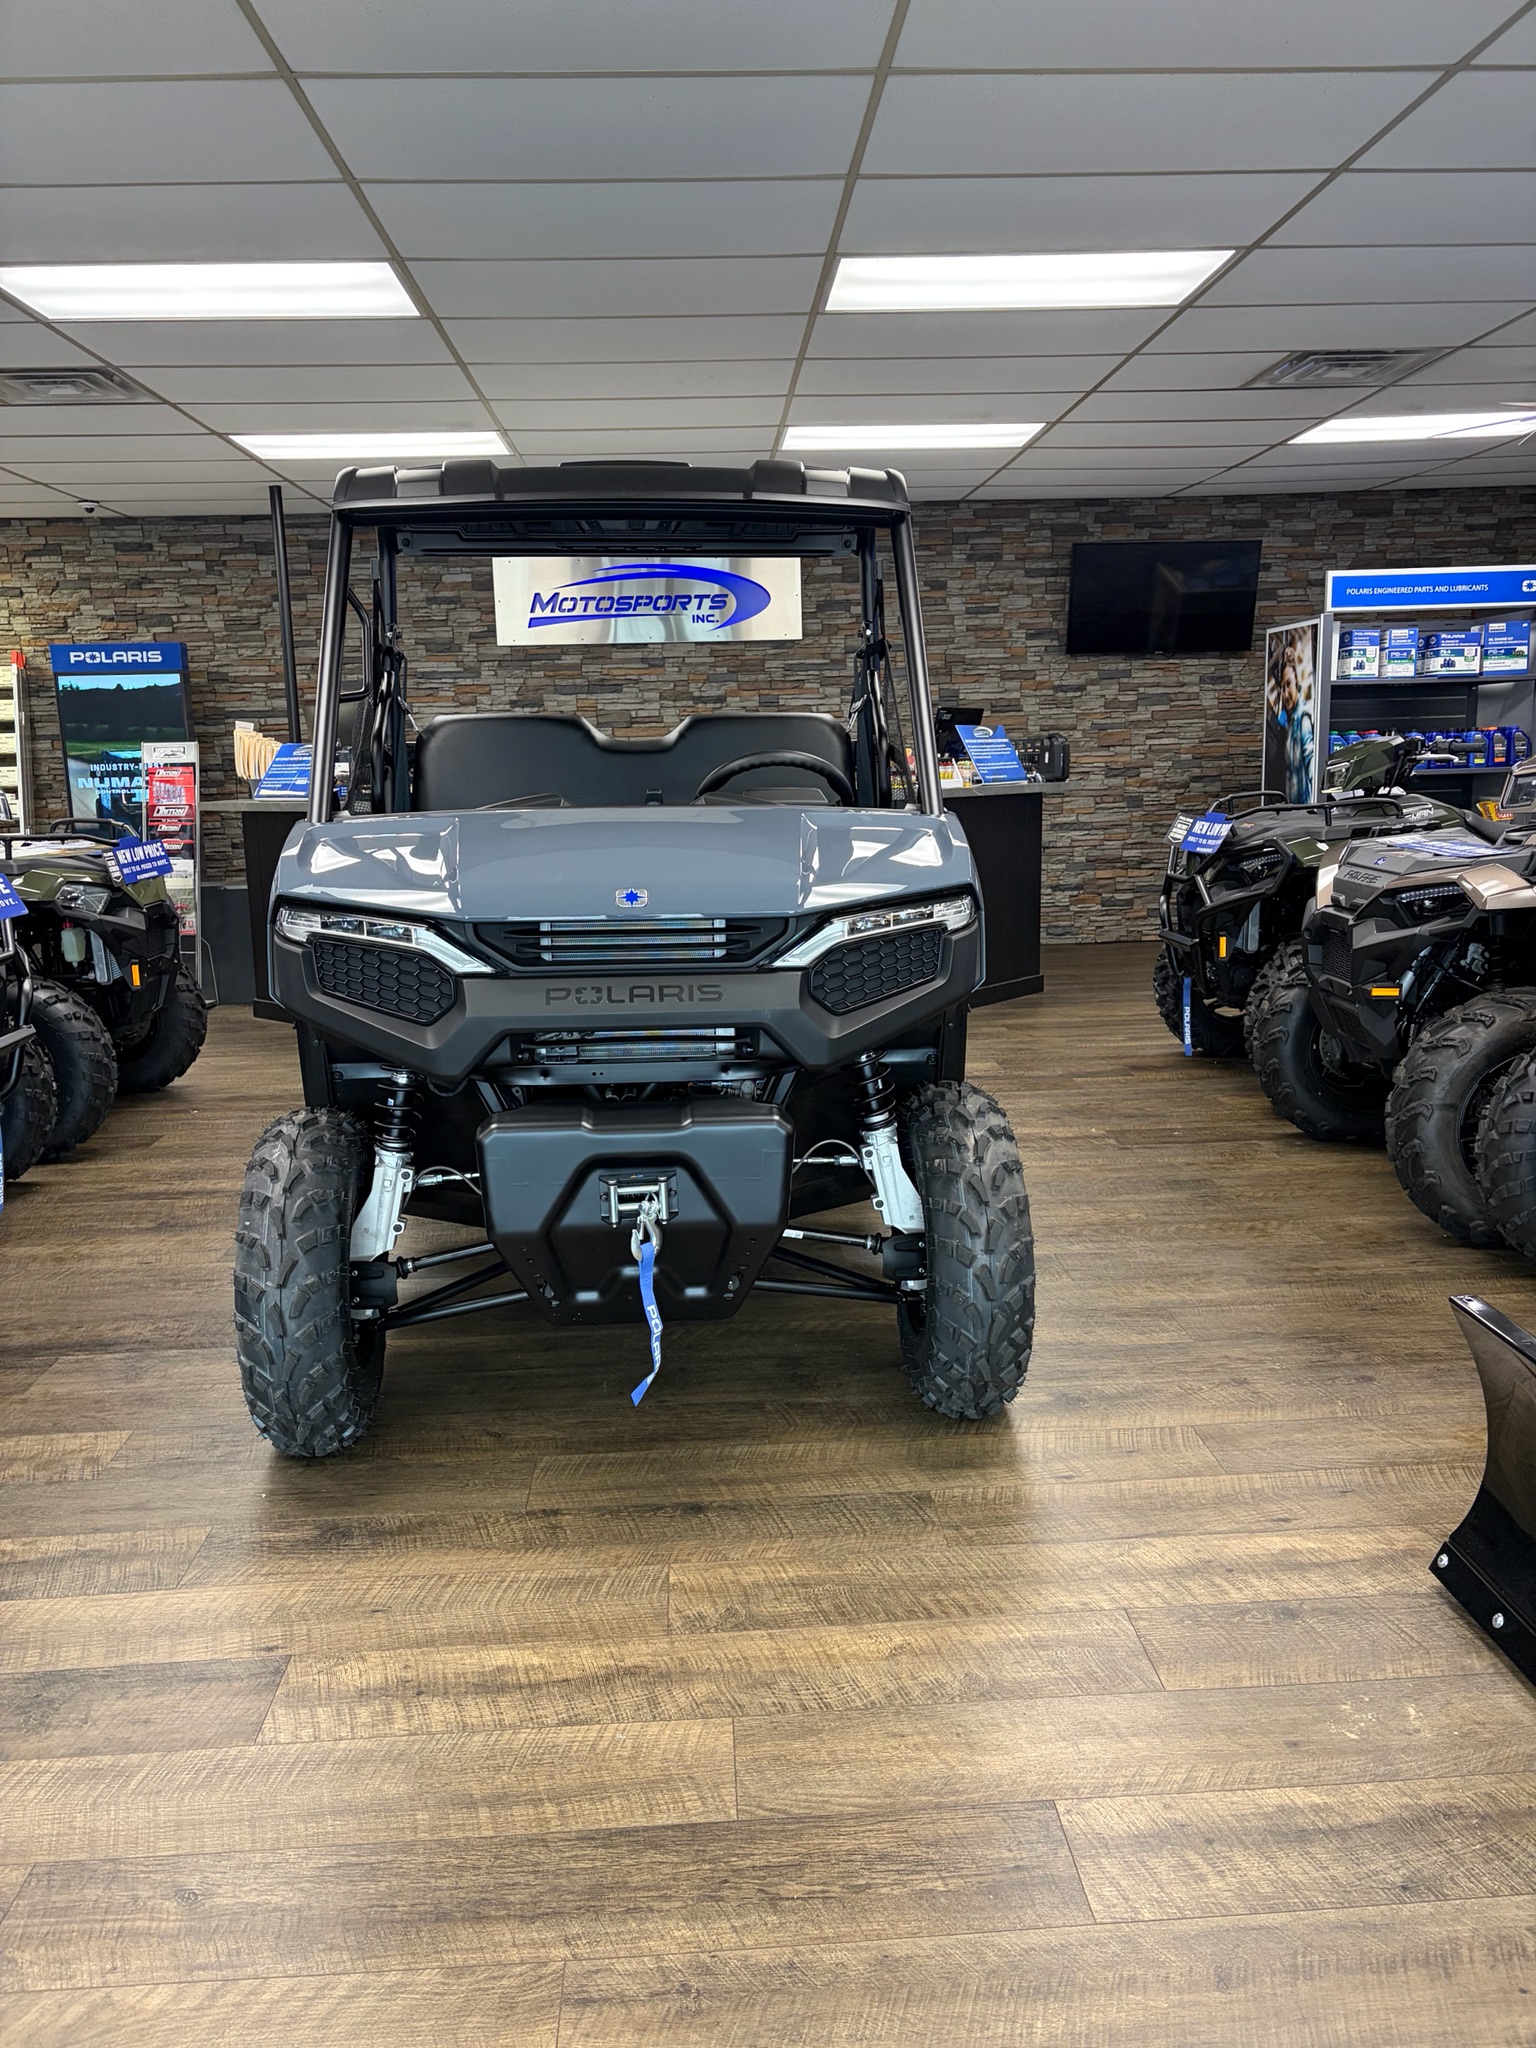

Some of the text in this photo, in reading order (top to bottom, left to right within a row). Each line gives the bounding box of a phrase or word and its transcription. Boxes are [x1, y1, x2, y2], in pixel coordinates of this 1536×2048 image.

[1373, 586, 1413, 594] ENGINEERED
[529, 592, 729, 614] MOTOSPORTS
[691, 613, 720, 624] INC.
[69, 651, 163, 664] POLARIS
[1192, 820, 1210, 835] NEW
[115, 842, 165, 865] NEW LOW PRICE
[545, 983, 724, 1006] POLARIS
